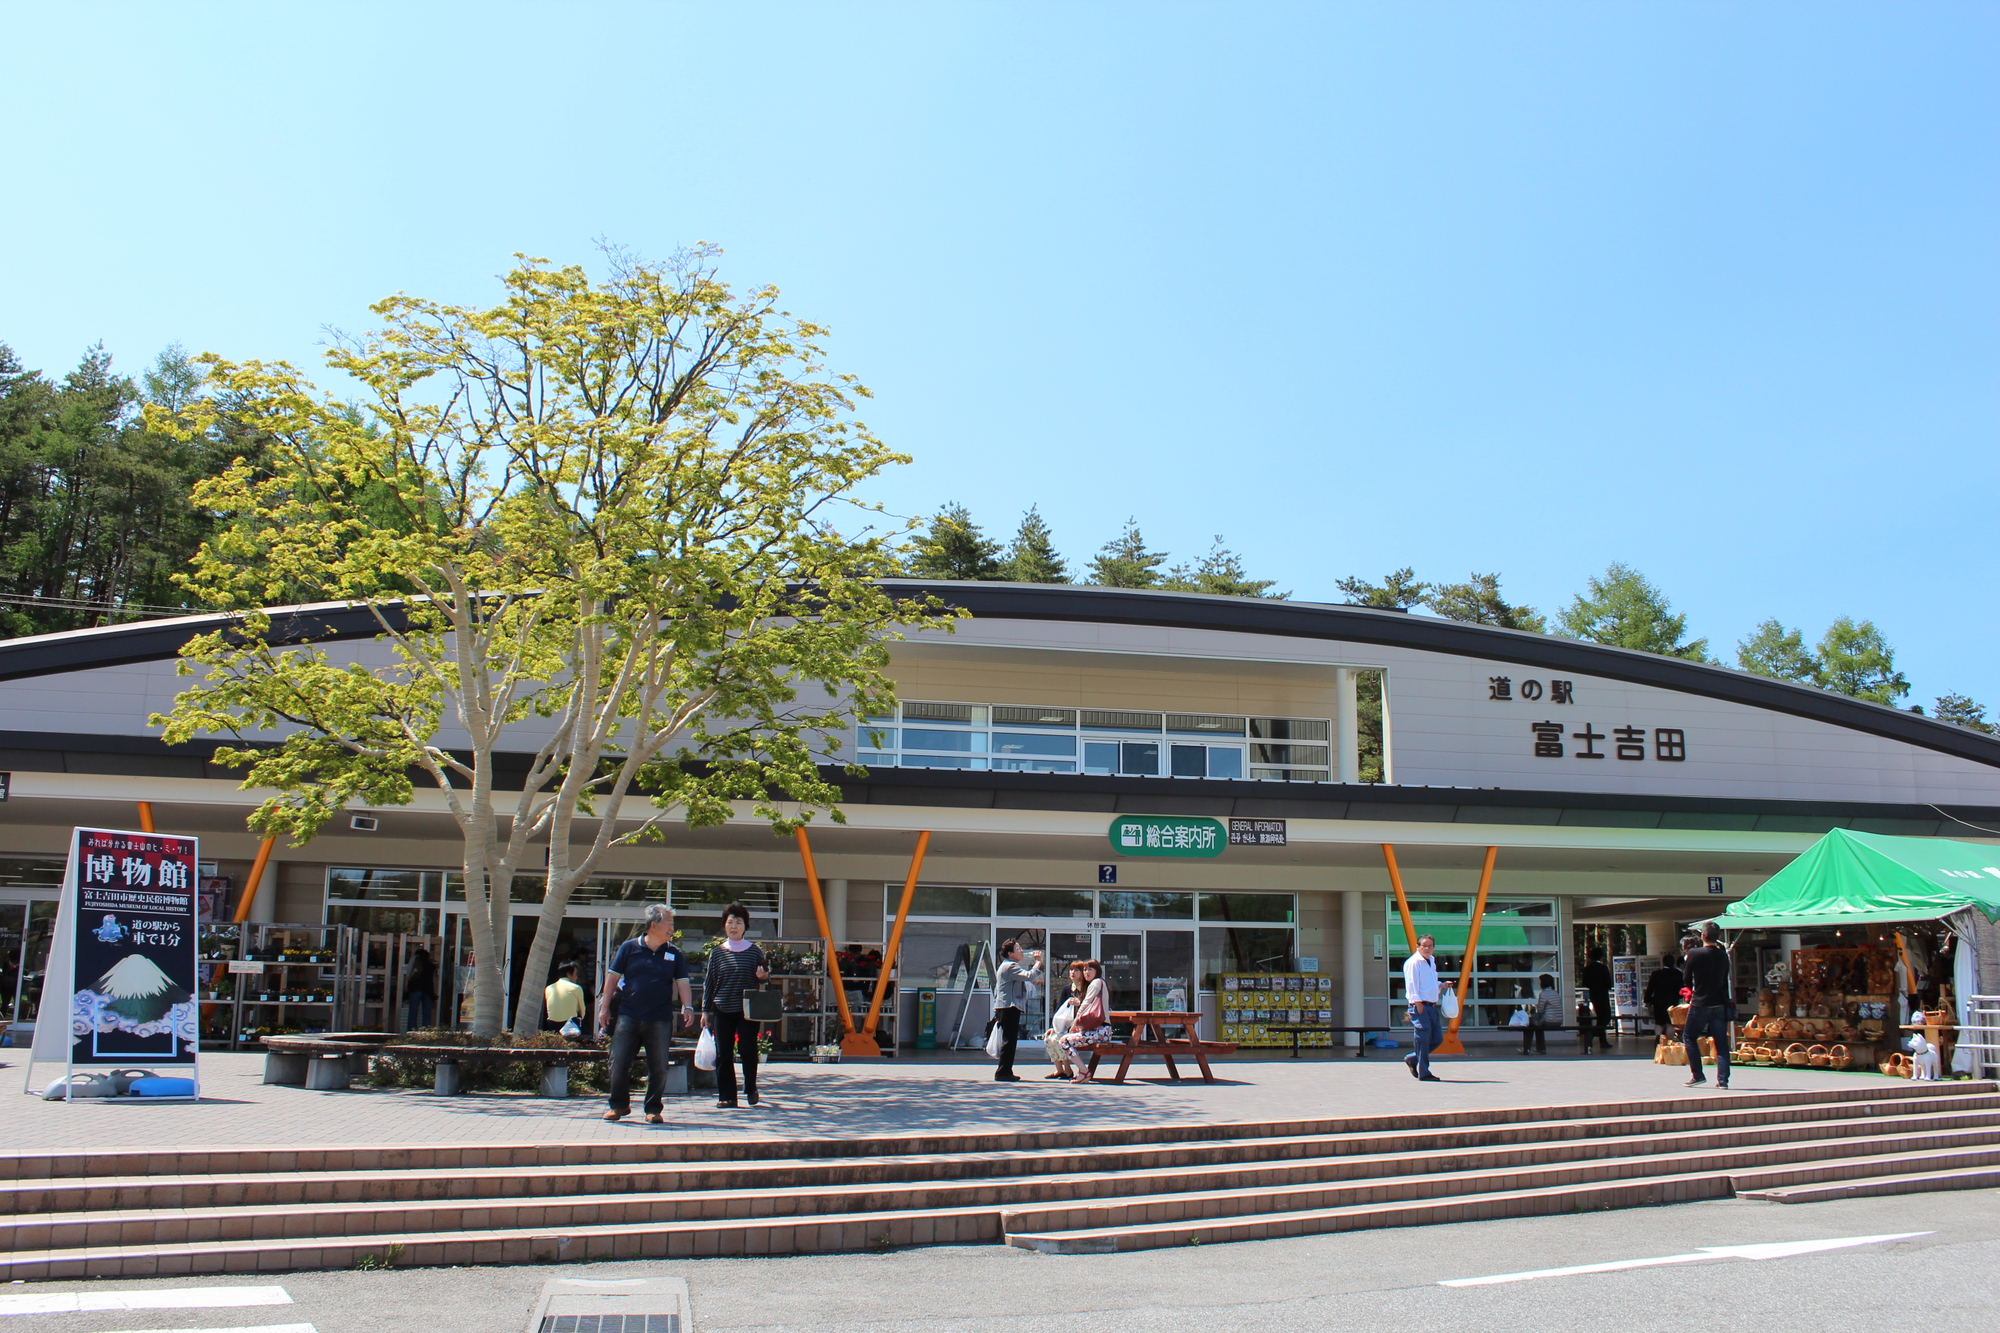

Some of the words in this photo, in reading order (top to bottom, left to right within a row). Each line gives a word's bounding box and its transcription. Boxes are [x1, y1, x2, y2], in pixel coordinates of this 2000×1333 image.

[1489, 676, 1574, 705] 道の駅
[1532, 720, 1686, 762] 富士吉田
[1231, 820, 1253, 832] GENERAL
[1254, 821, 1284, 832] INFORMATION
[1146, 824, 1216, 850] 総合案内所
[84, 854, 188, 889] 博物館
[84, 890, 188, 906] 富士吉田市歴史民俗博物館
[132, 919, 181, 932] 道の駅から
[132, 932, 181, 947] 車で1分
